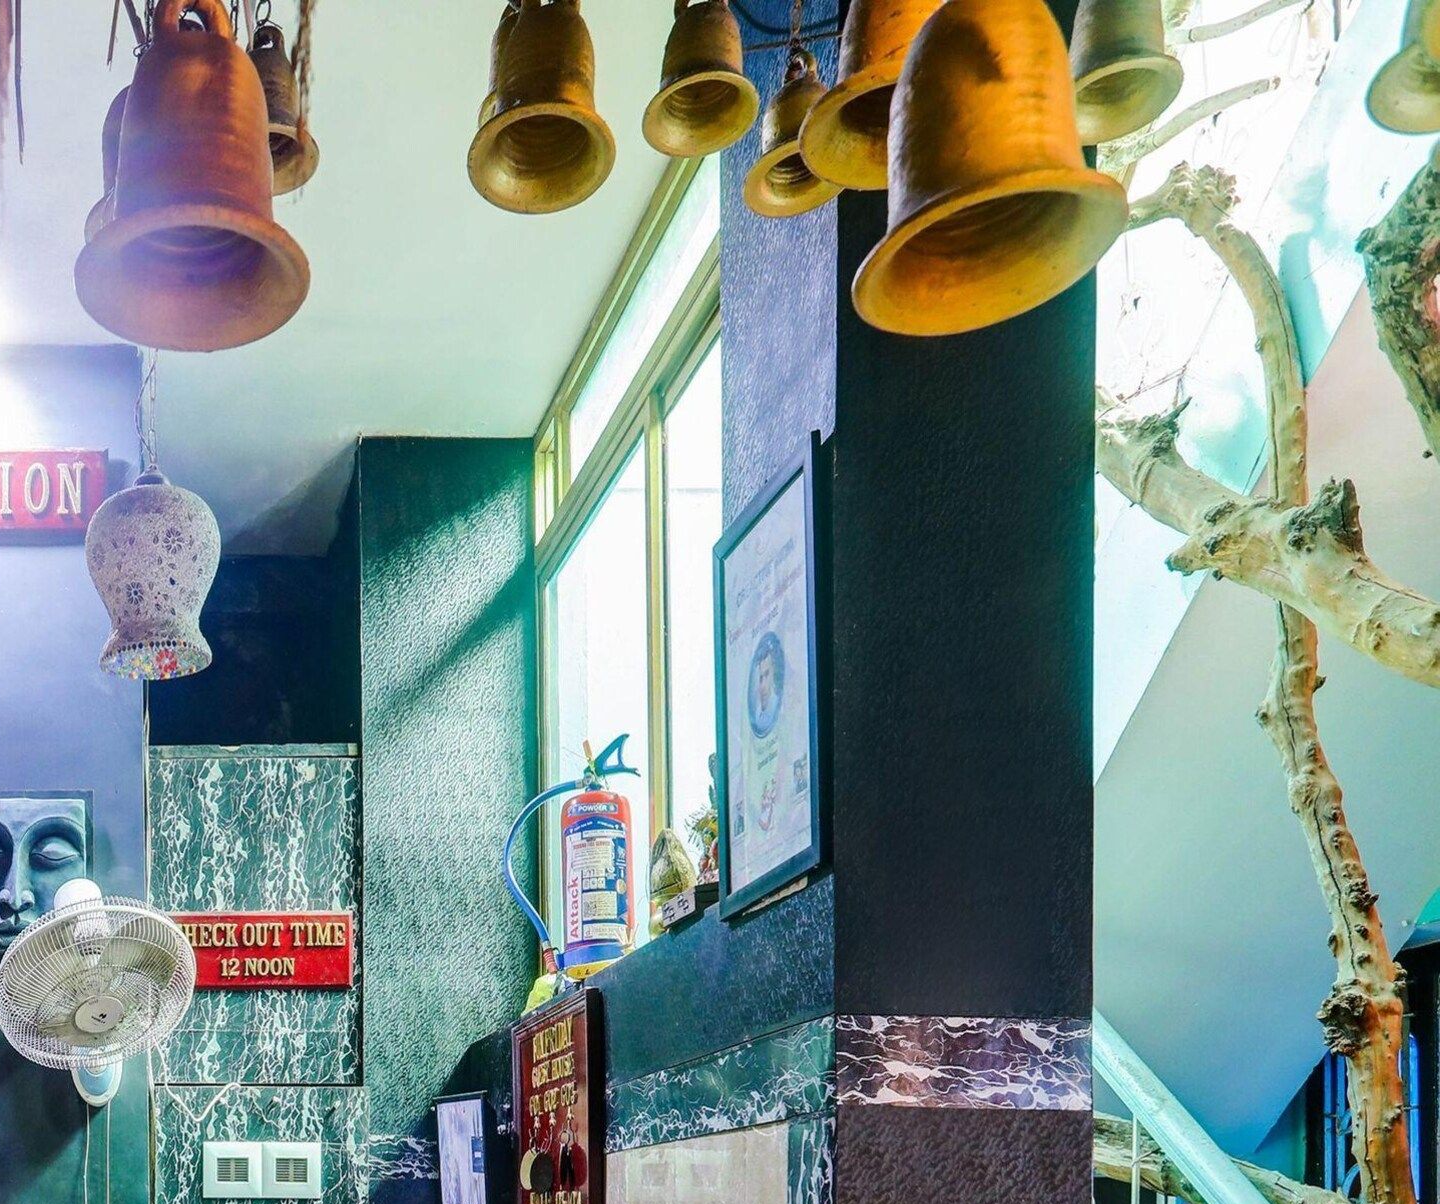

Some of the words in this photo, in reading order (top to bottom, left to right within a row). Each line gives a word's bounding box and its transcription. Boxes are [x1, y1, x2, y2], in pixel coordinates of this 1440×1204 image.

[177, 922, 238, 948] HECK
[242, 922, 284, 948] OUT
[290, 922, 346, 947] TIME
[220, 957, 241, 977] 12
[244, 957, 296, 977] NOON
